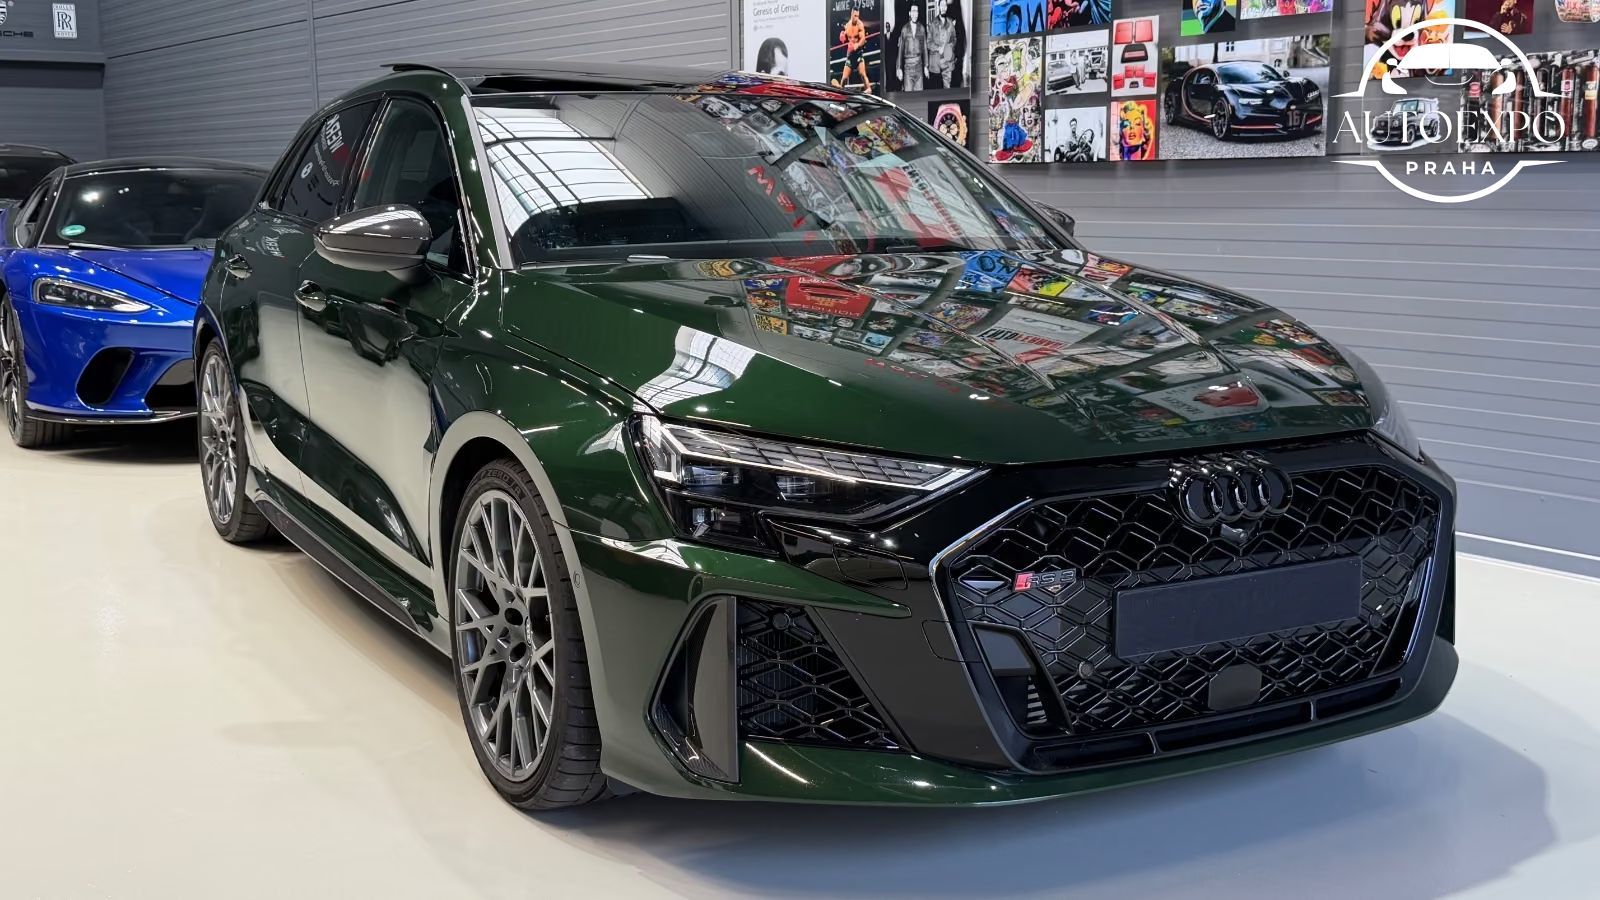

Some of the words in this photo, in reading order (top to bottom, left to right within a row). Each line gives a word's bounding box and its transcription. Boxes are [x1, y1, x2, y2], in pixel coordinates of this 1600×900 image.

[753, 7, 773, 16] Genesis
[773, 4, 779, 13] of
[780, 3, 798, 12] Genius
